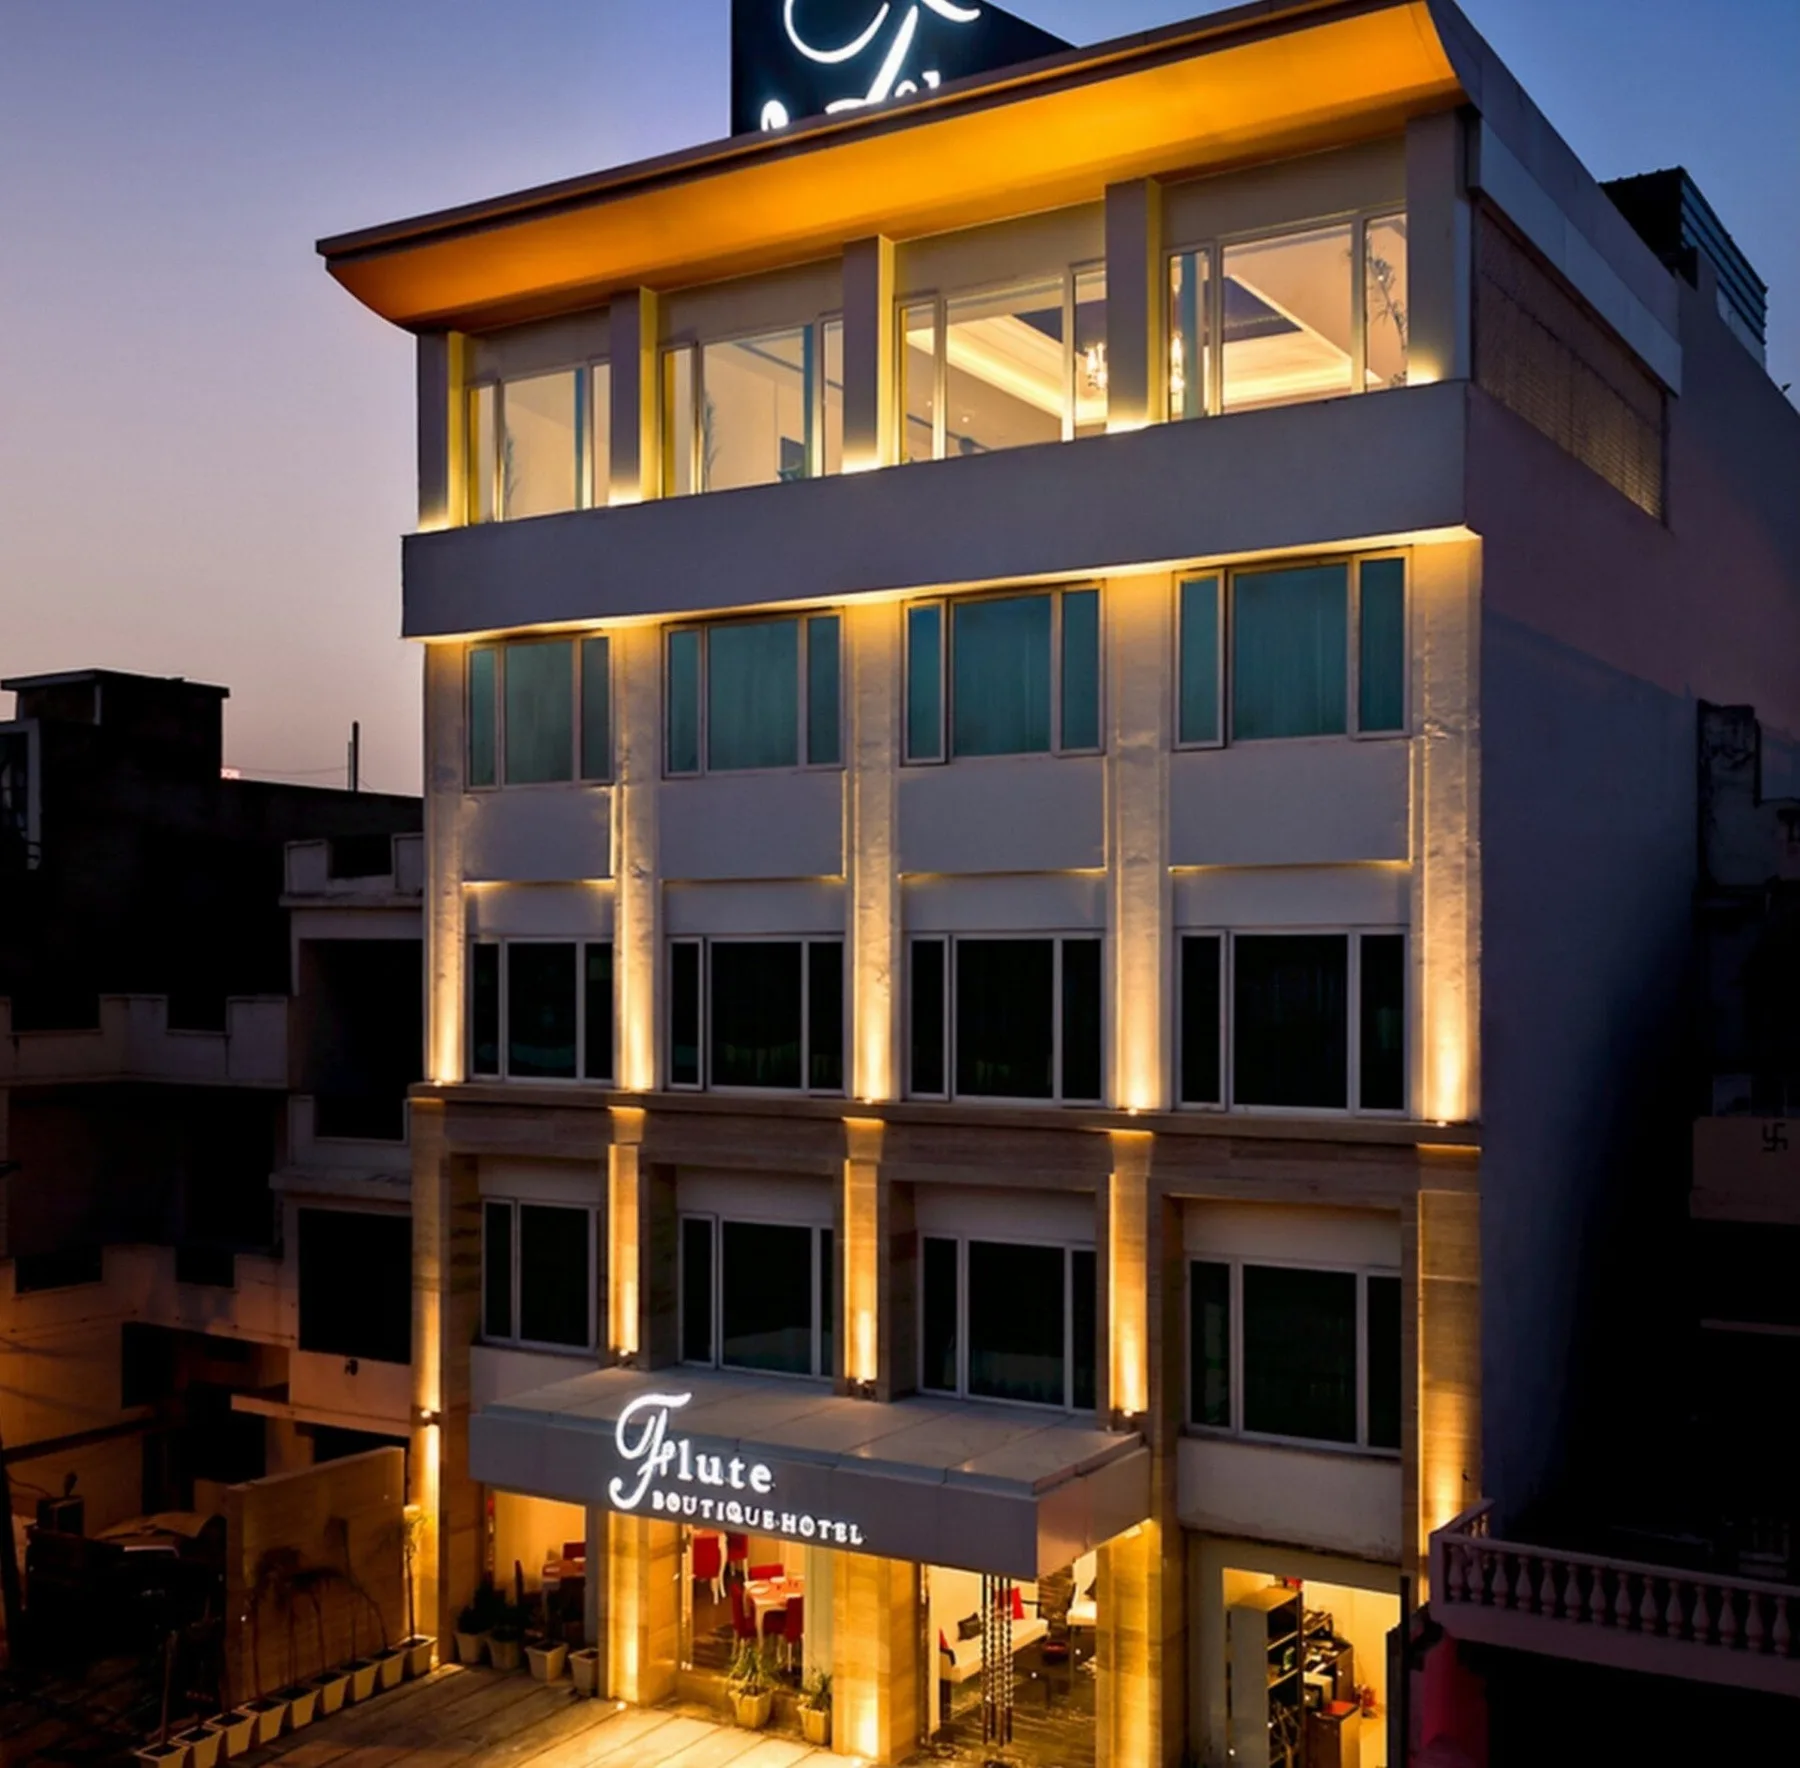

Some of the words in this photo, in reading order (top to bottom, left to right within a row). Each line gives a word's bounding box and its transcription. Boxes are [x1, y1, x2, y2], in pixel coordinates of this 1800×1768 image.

[609, 1392, 774, 1509] Flute
[651, 1490, 775, 1529] BOUTIQUE
[781, 1513, 863, 1545] HOTEL
